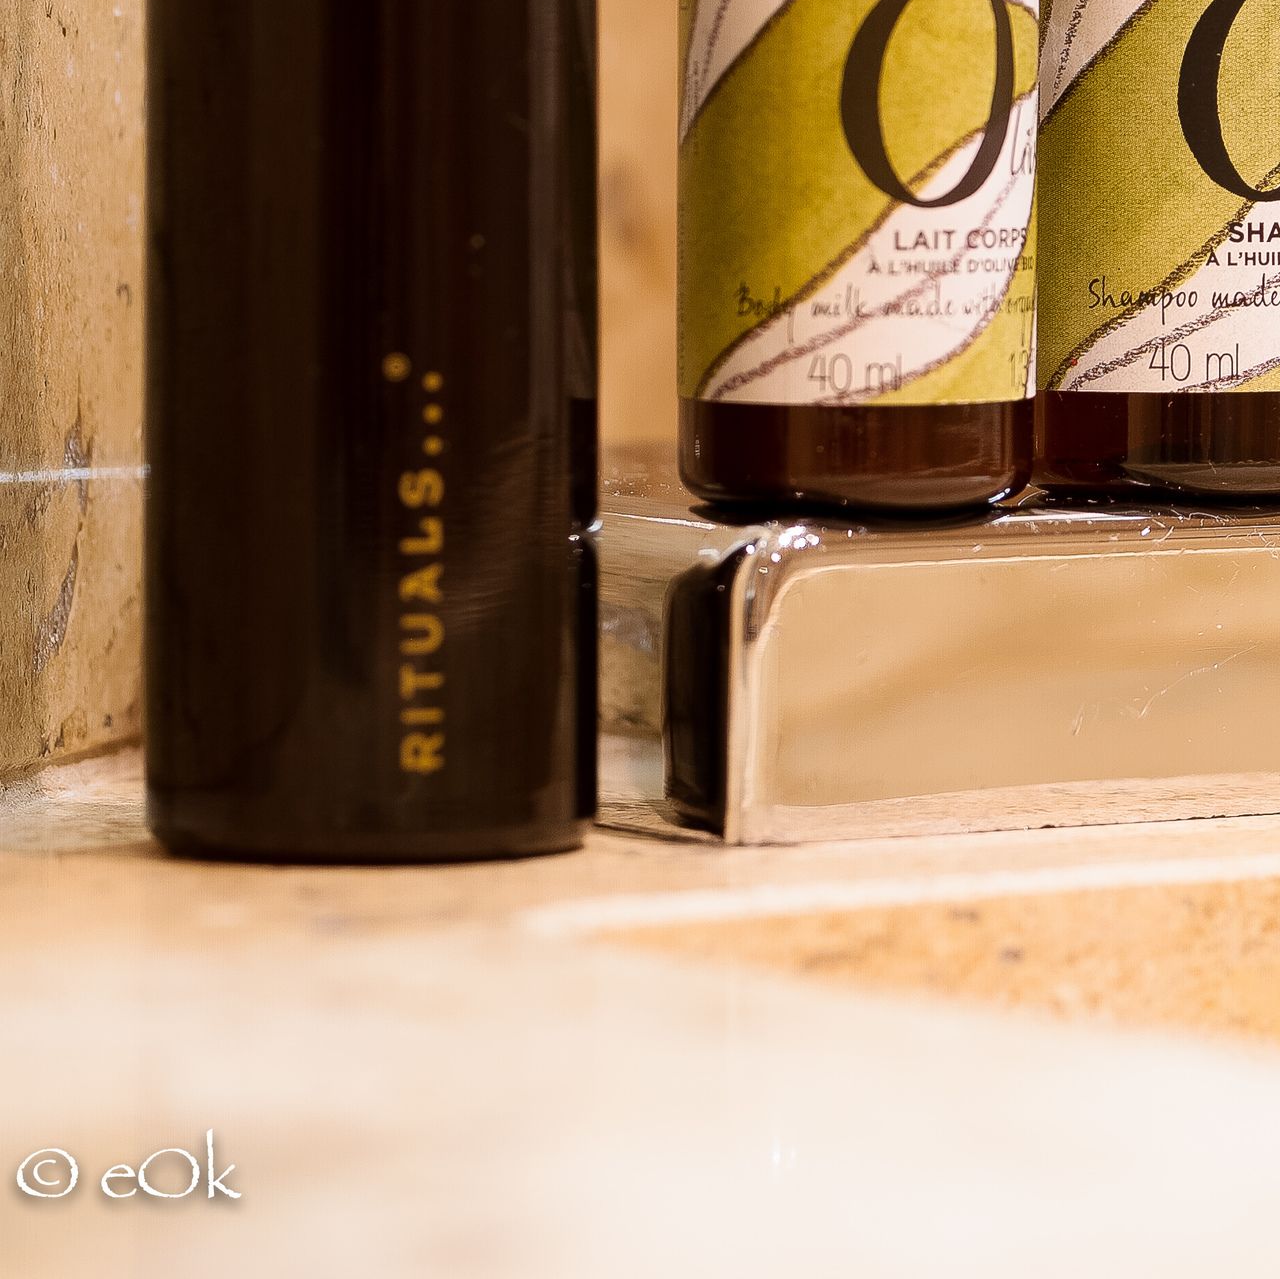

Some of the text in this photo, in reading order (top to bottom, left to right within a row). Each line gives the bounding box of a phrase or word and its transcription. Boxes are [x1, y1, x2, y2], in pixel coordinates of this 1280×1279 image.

[894, 227, 1027, 251] LAIT CORPS
[1087, 275, 1198, 325] Shampoo
[808, 352, 853, 394] 40
[865, 353, 902, 392] ml
[1149, 338, 1191, 382] 40
[1206, 343, 1239, 381] ml
